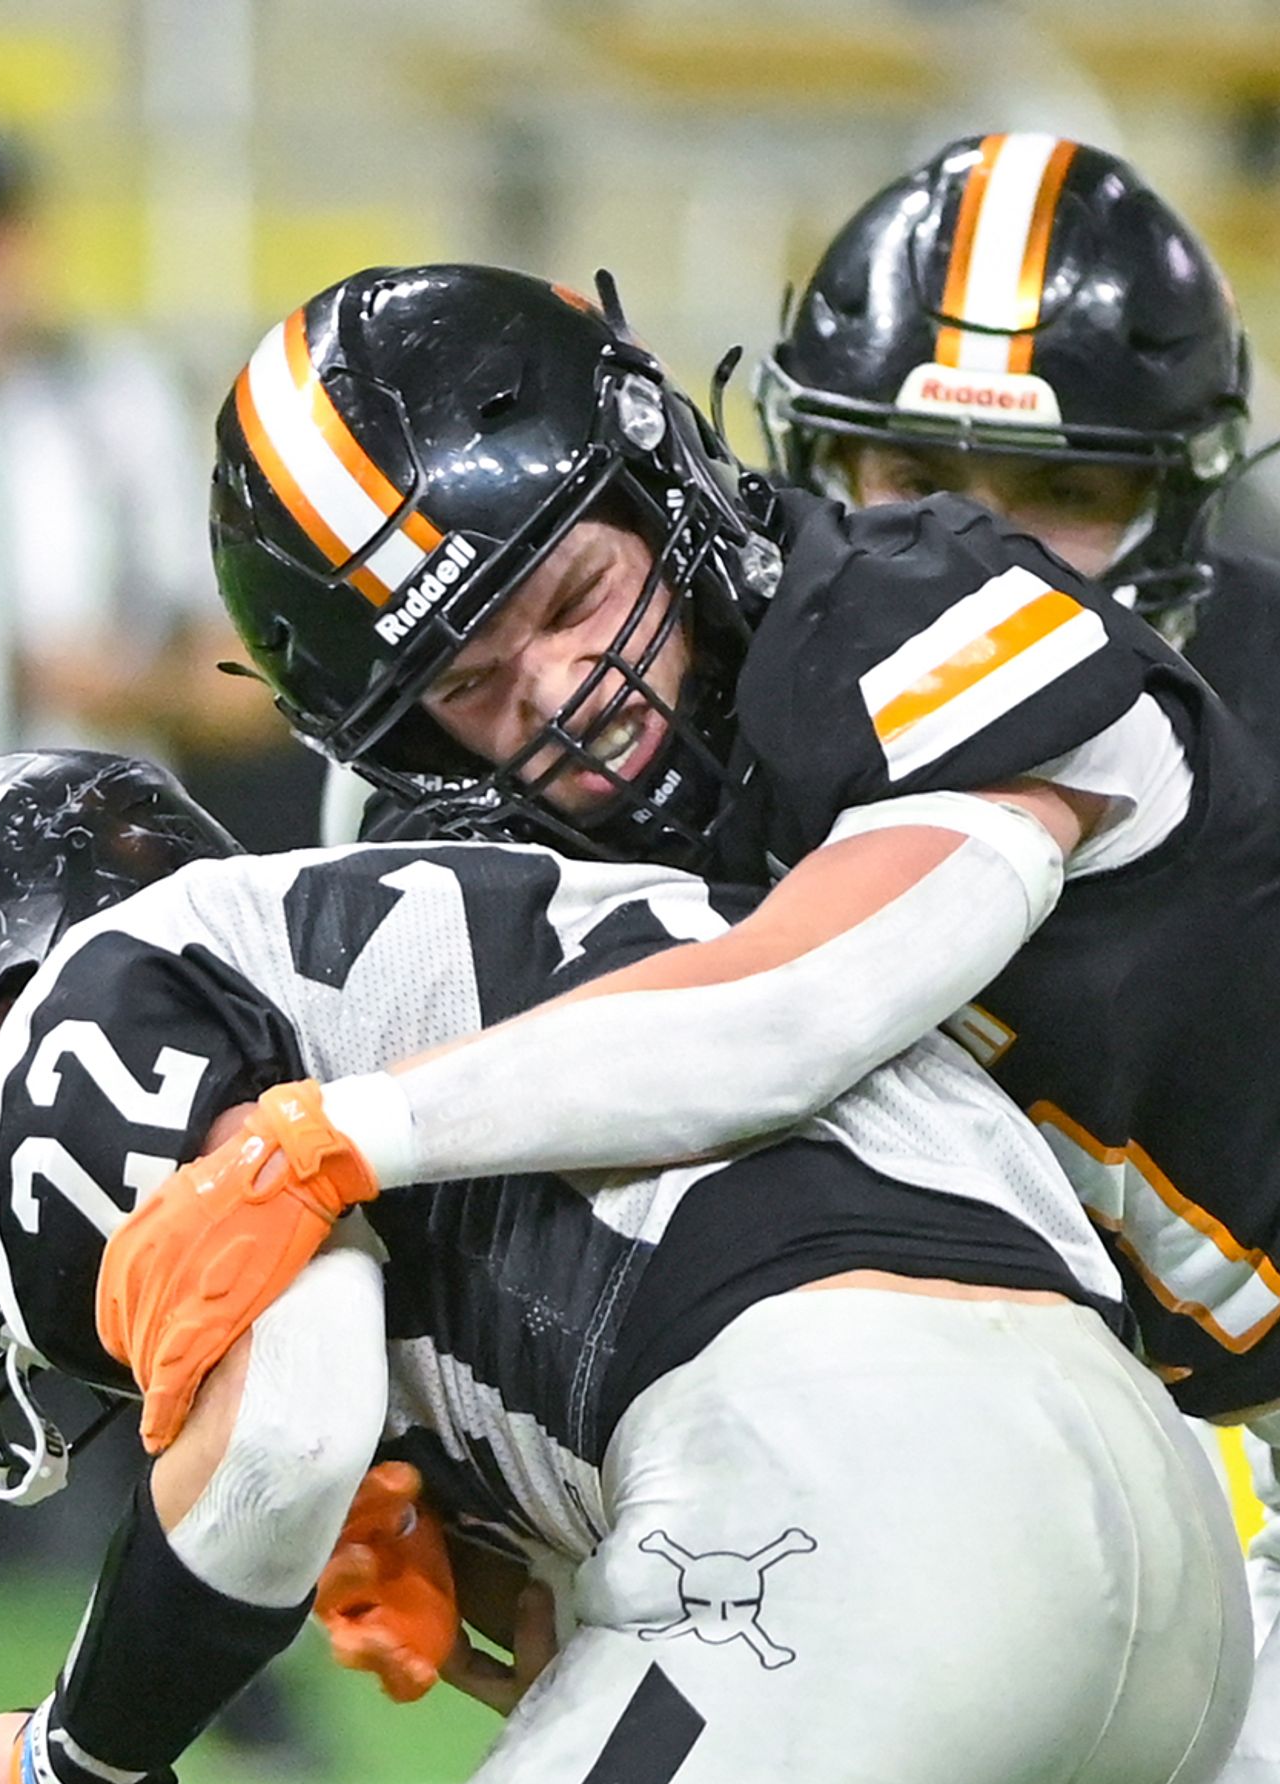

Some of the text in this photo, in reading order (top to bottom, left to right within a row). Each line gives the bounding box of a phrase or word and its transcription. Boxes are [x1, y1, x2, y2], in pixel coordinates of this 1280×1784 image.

[920, 378, 1038, 411] Riddell
[373, 533, 477, 646] Riddell
[11, 1018, 210, 1241] 22
